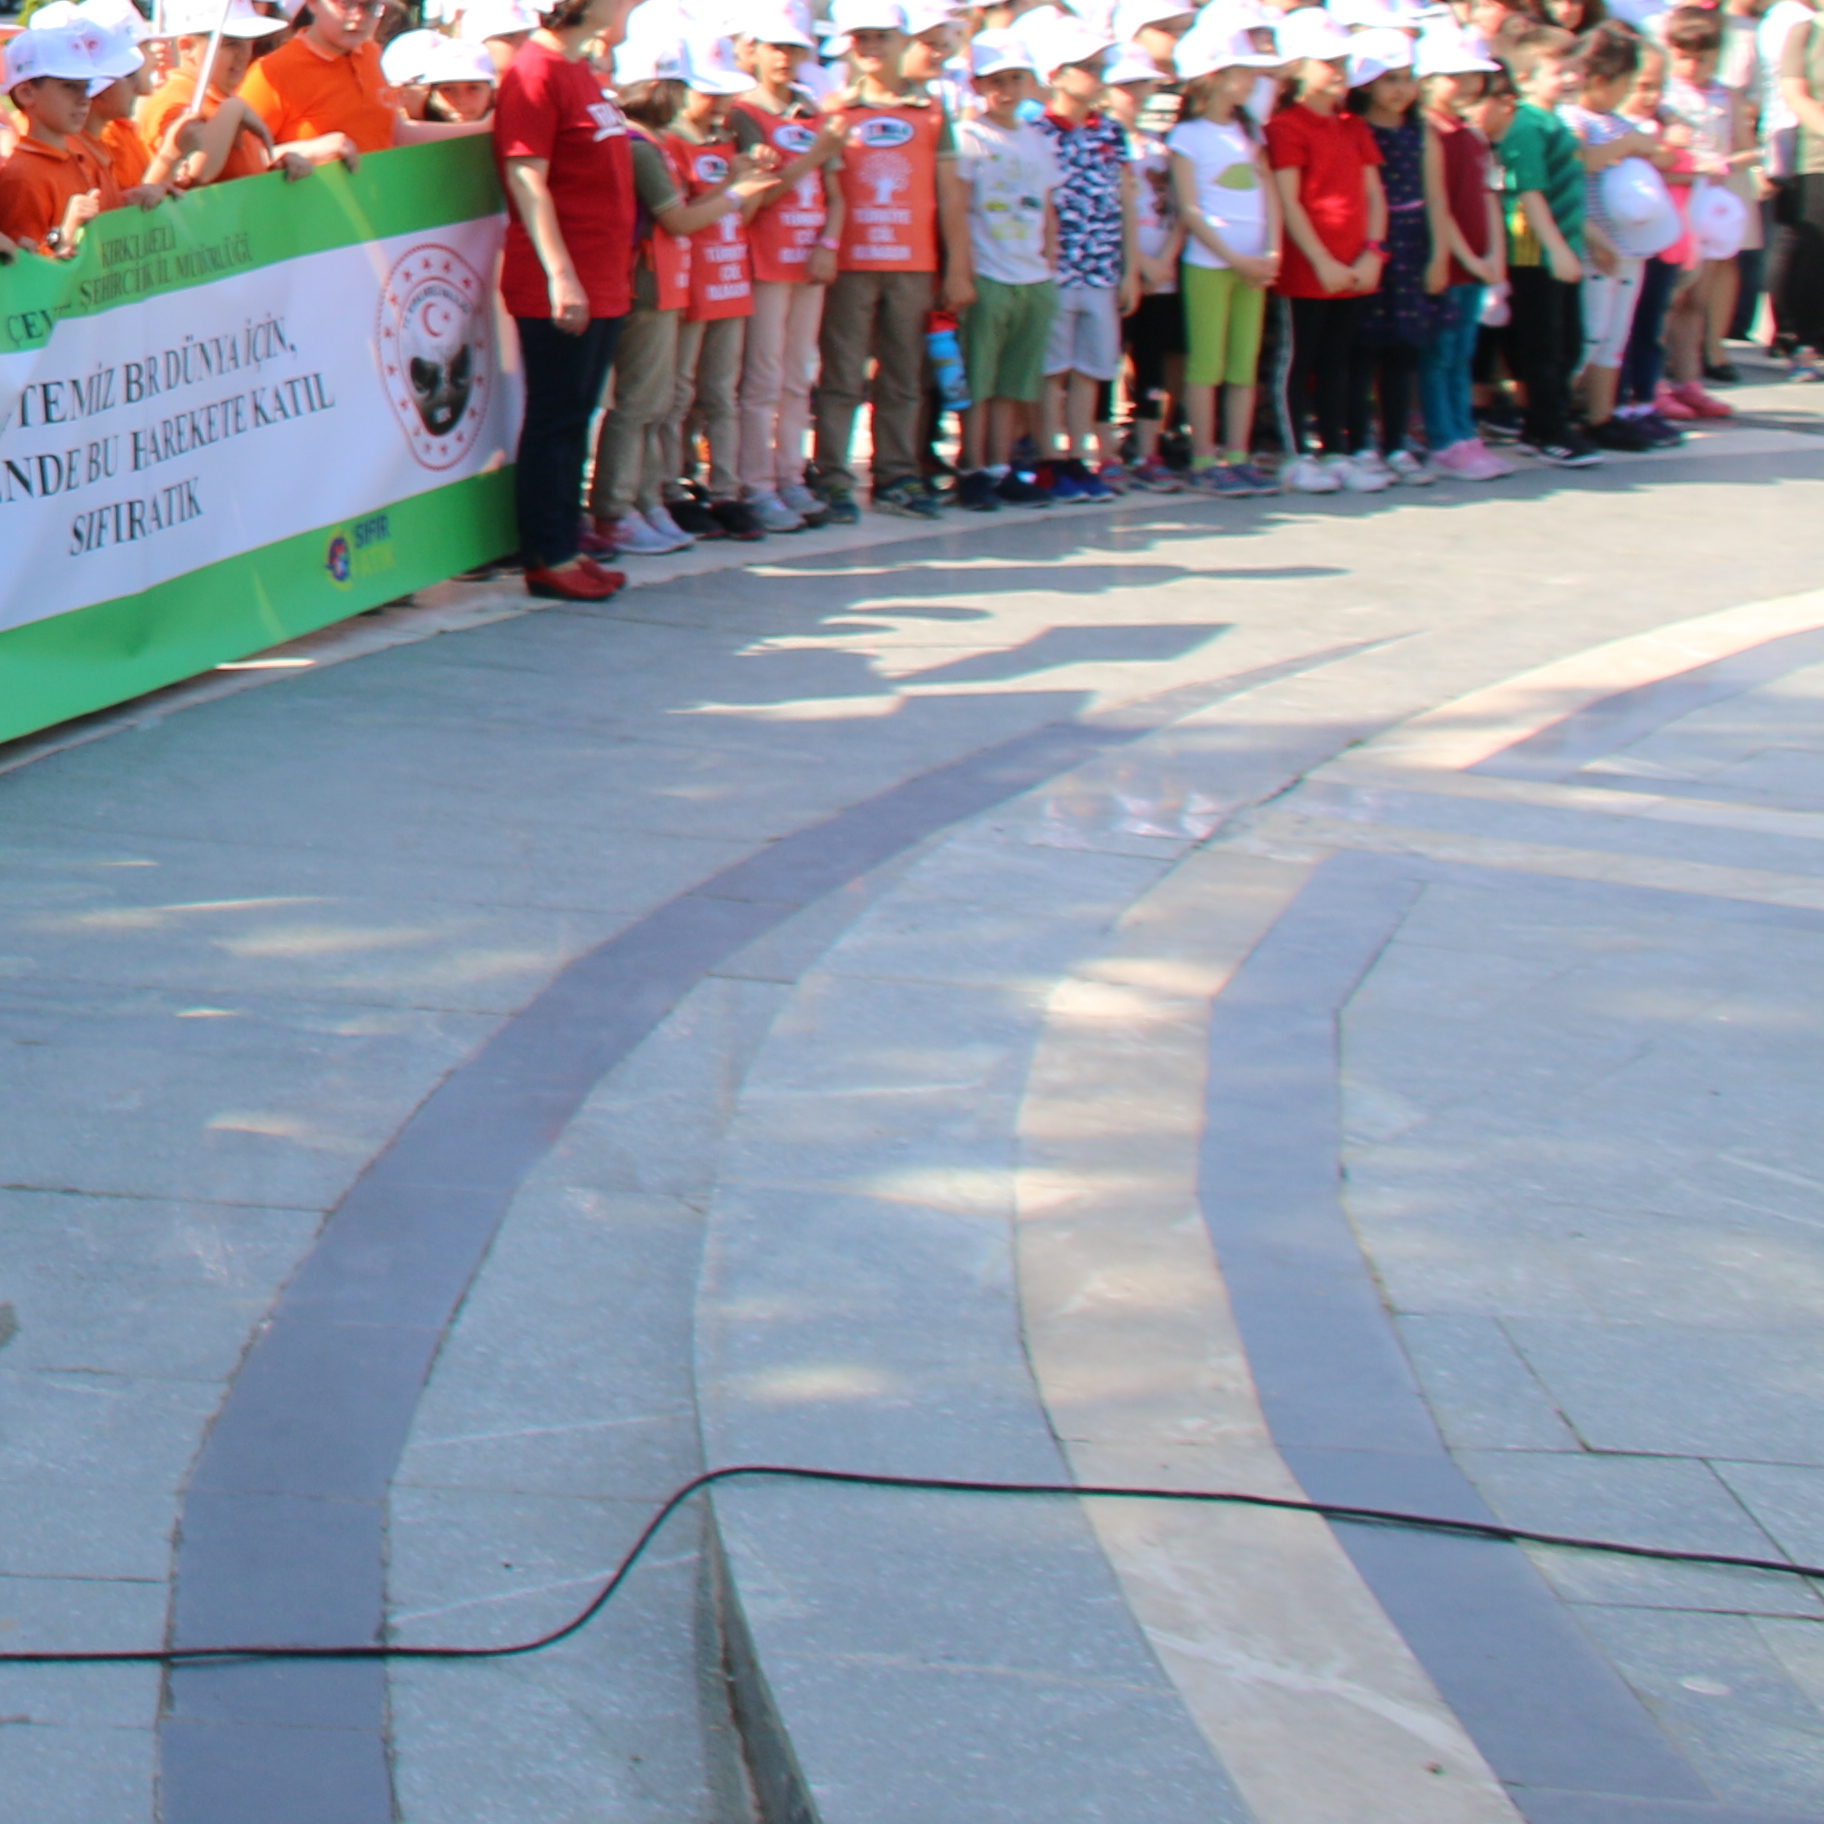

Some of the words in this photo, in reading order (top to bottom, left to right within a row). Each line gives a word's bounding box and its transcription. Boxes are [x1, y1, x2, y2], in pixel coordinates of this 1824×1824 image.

[165, 334, 240, 391] DÜNYA
[88, 434, 120, 483] BU
[251, 373, 336, 429] KATIL
[69, 499, 146, 557] SIFIR
[145, 477, 205, 535] ATIK
